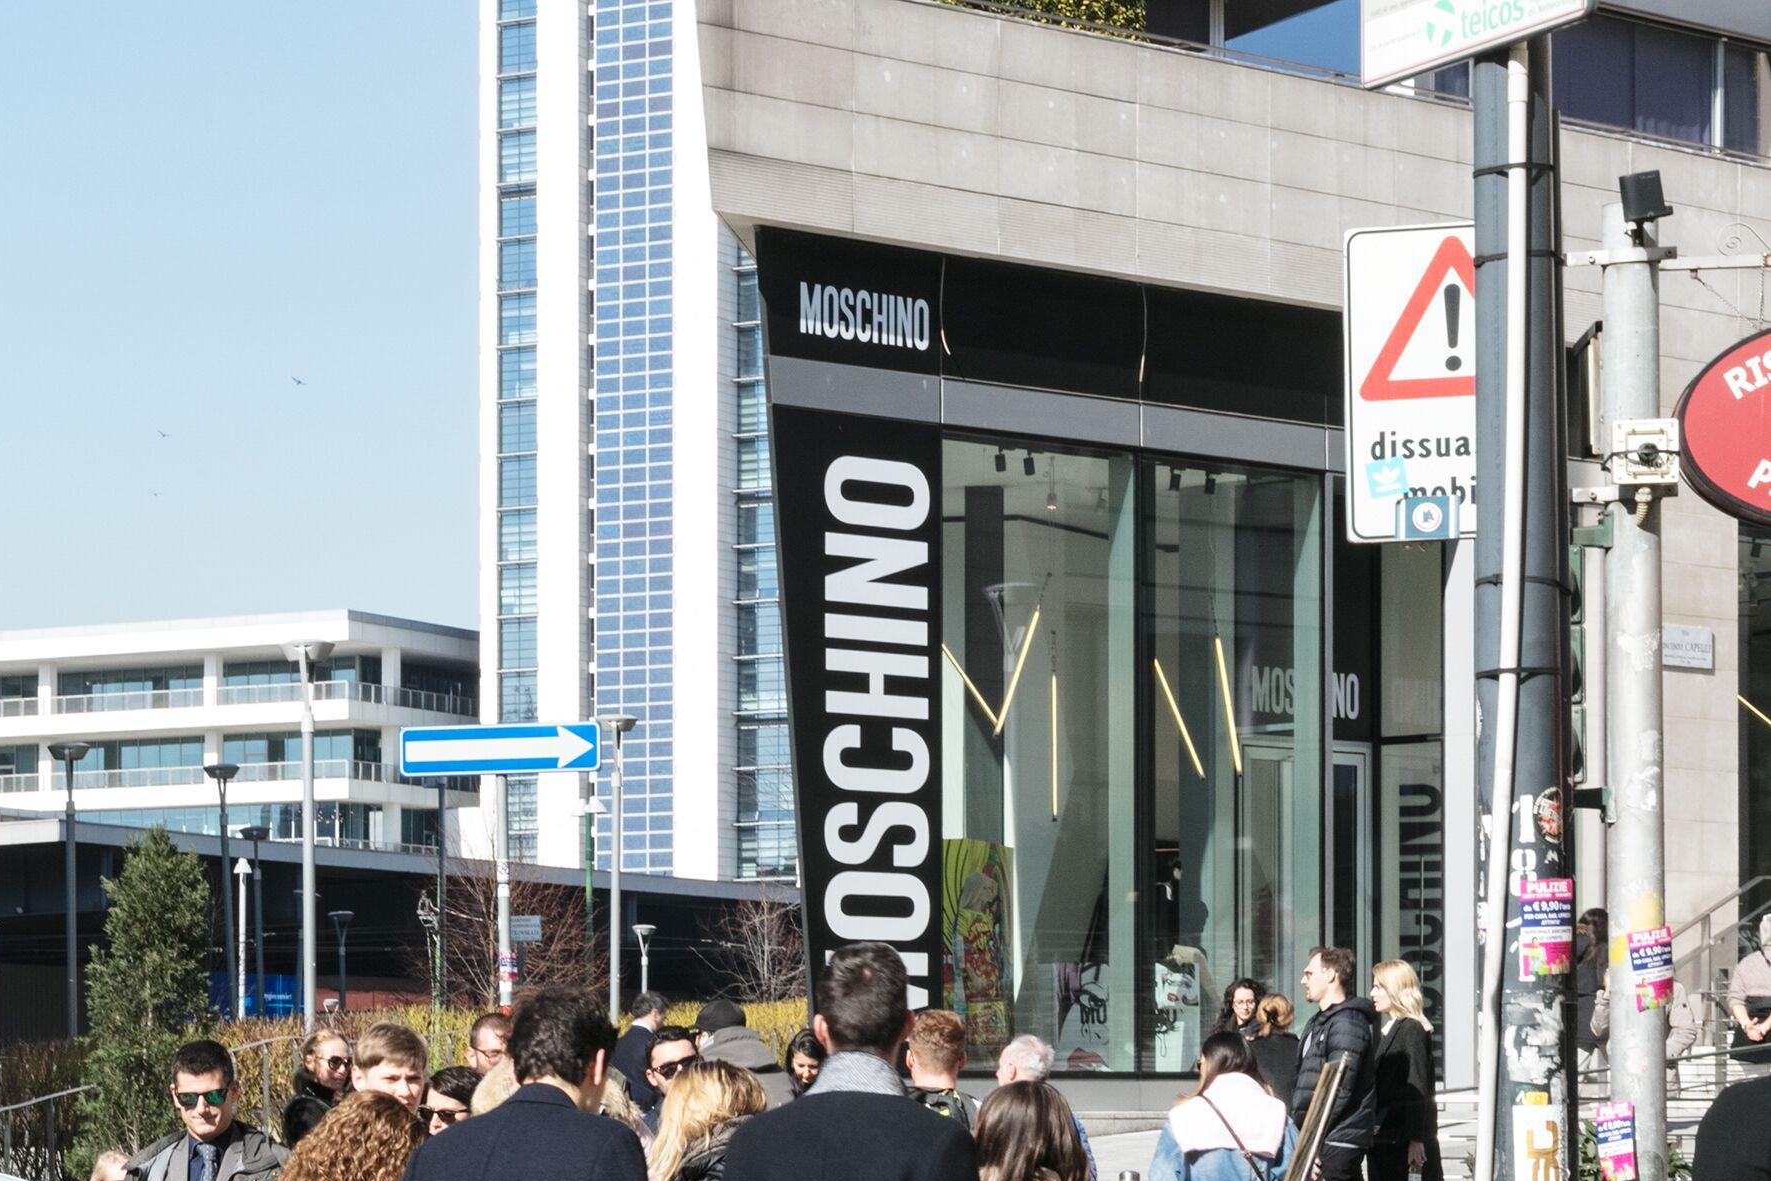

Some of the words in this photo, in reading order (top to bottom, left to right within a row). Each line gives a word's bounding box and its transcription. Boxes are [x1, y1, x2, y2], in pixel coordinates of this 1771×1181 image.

[800, 281, 930, 351] MOSCHINO
[1371, 431, 1476, 461] dissua
[1251, 665, 1359, 720] MOSNO
[1527, 881, 1568, 893] PULIZIE
